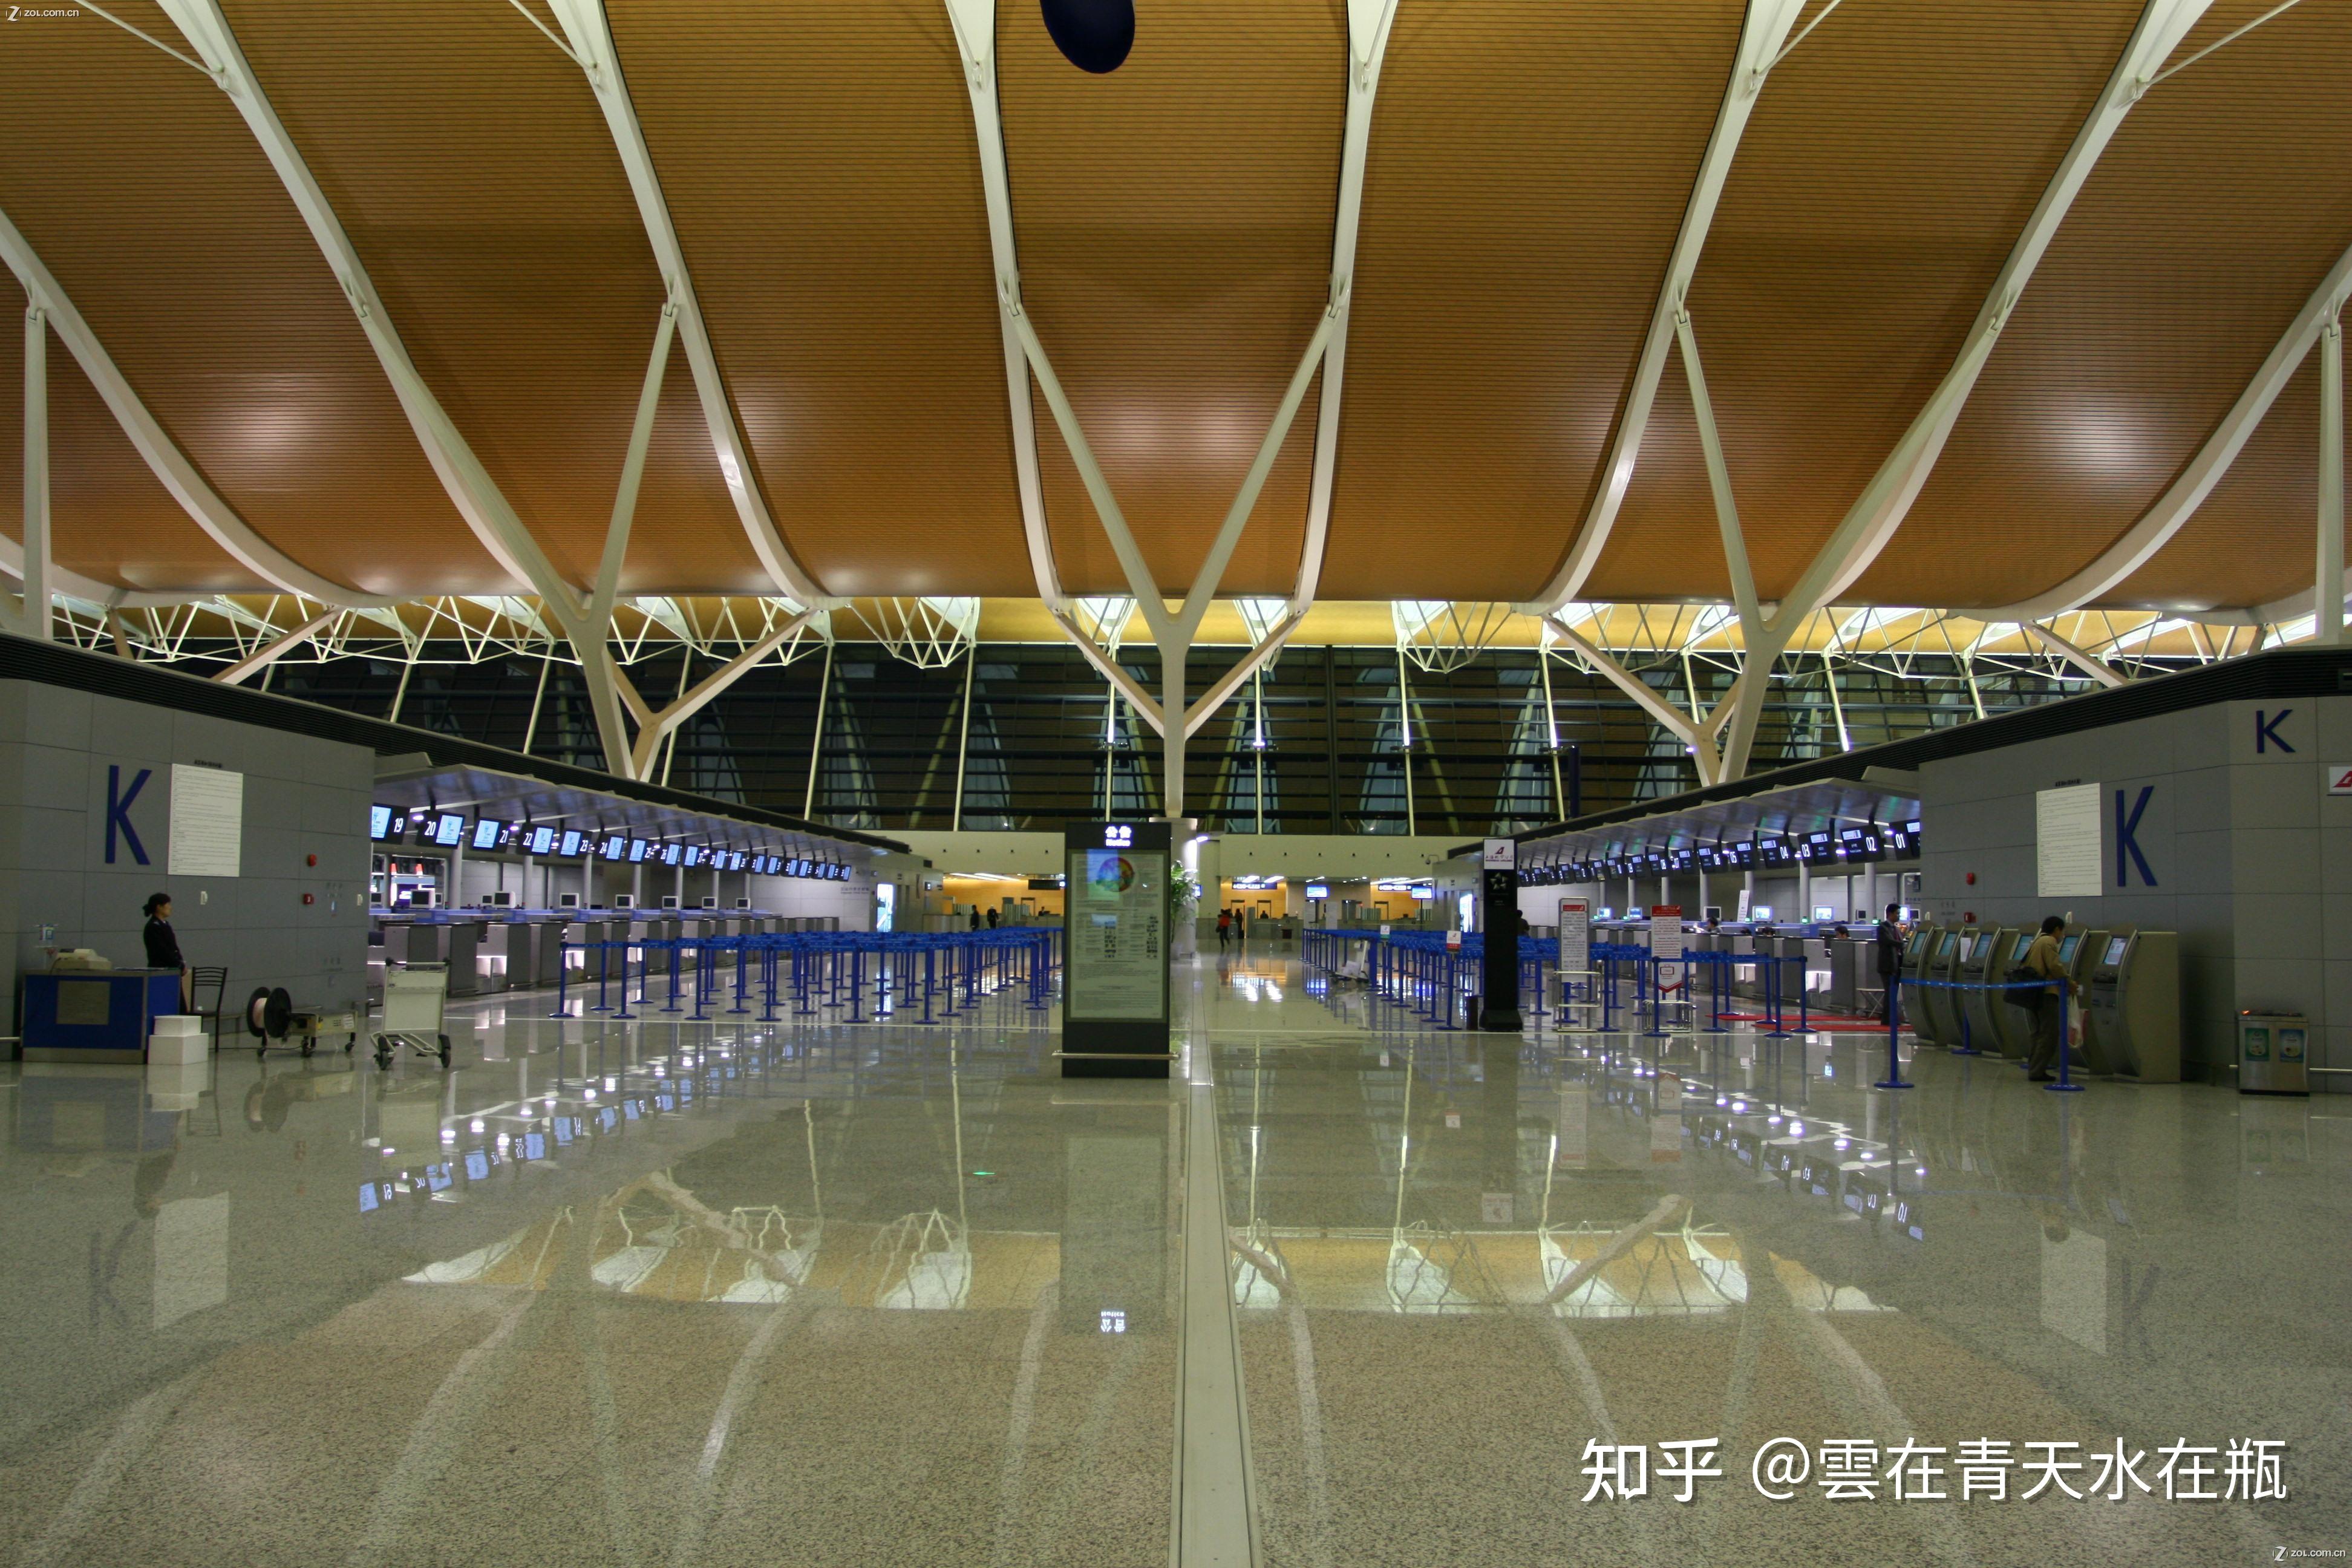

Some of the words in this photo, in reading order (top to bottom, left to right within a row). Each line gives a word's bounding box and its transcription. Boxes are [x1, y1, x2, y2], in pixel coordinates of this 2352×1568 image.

[2256, 709, 2296, 754] K
[105, 765, 153, 866] K
[393, 817, 404, 833] 19
[424, 821, 437, 836] 20
[1895, 833, 1906, 849] 01
[2115, 785, 2158, 887] K
[1780, 846, 1789, 859] 04
[1801, 844, 1811, 858] 03
[1865, 837, 1877, 852] 02
